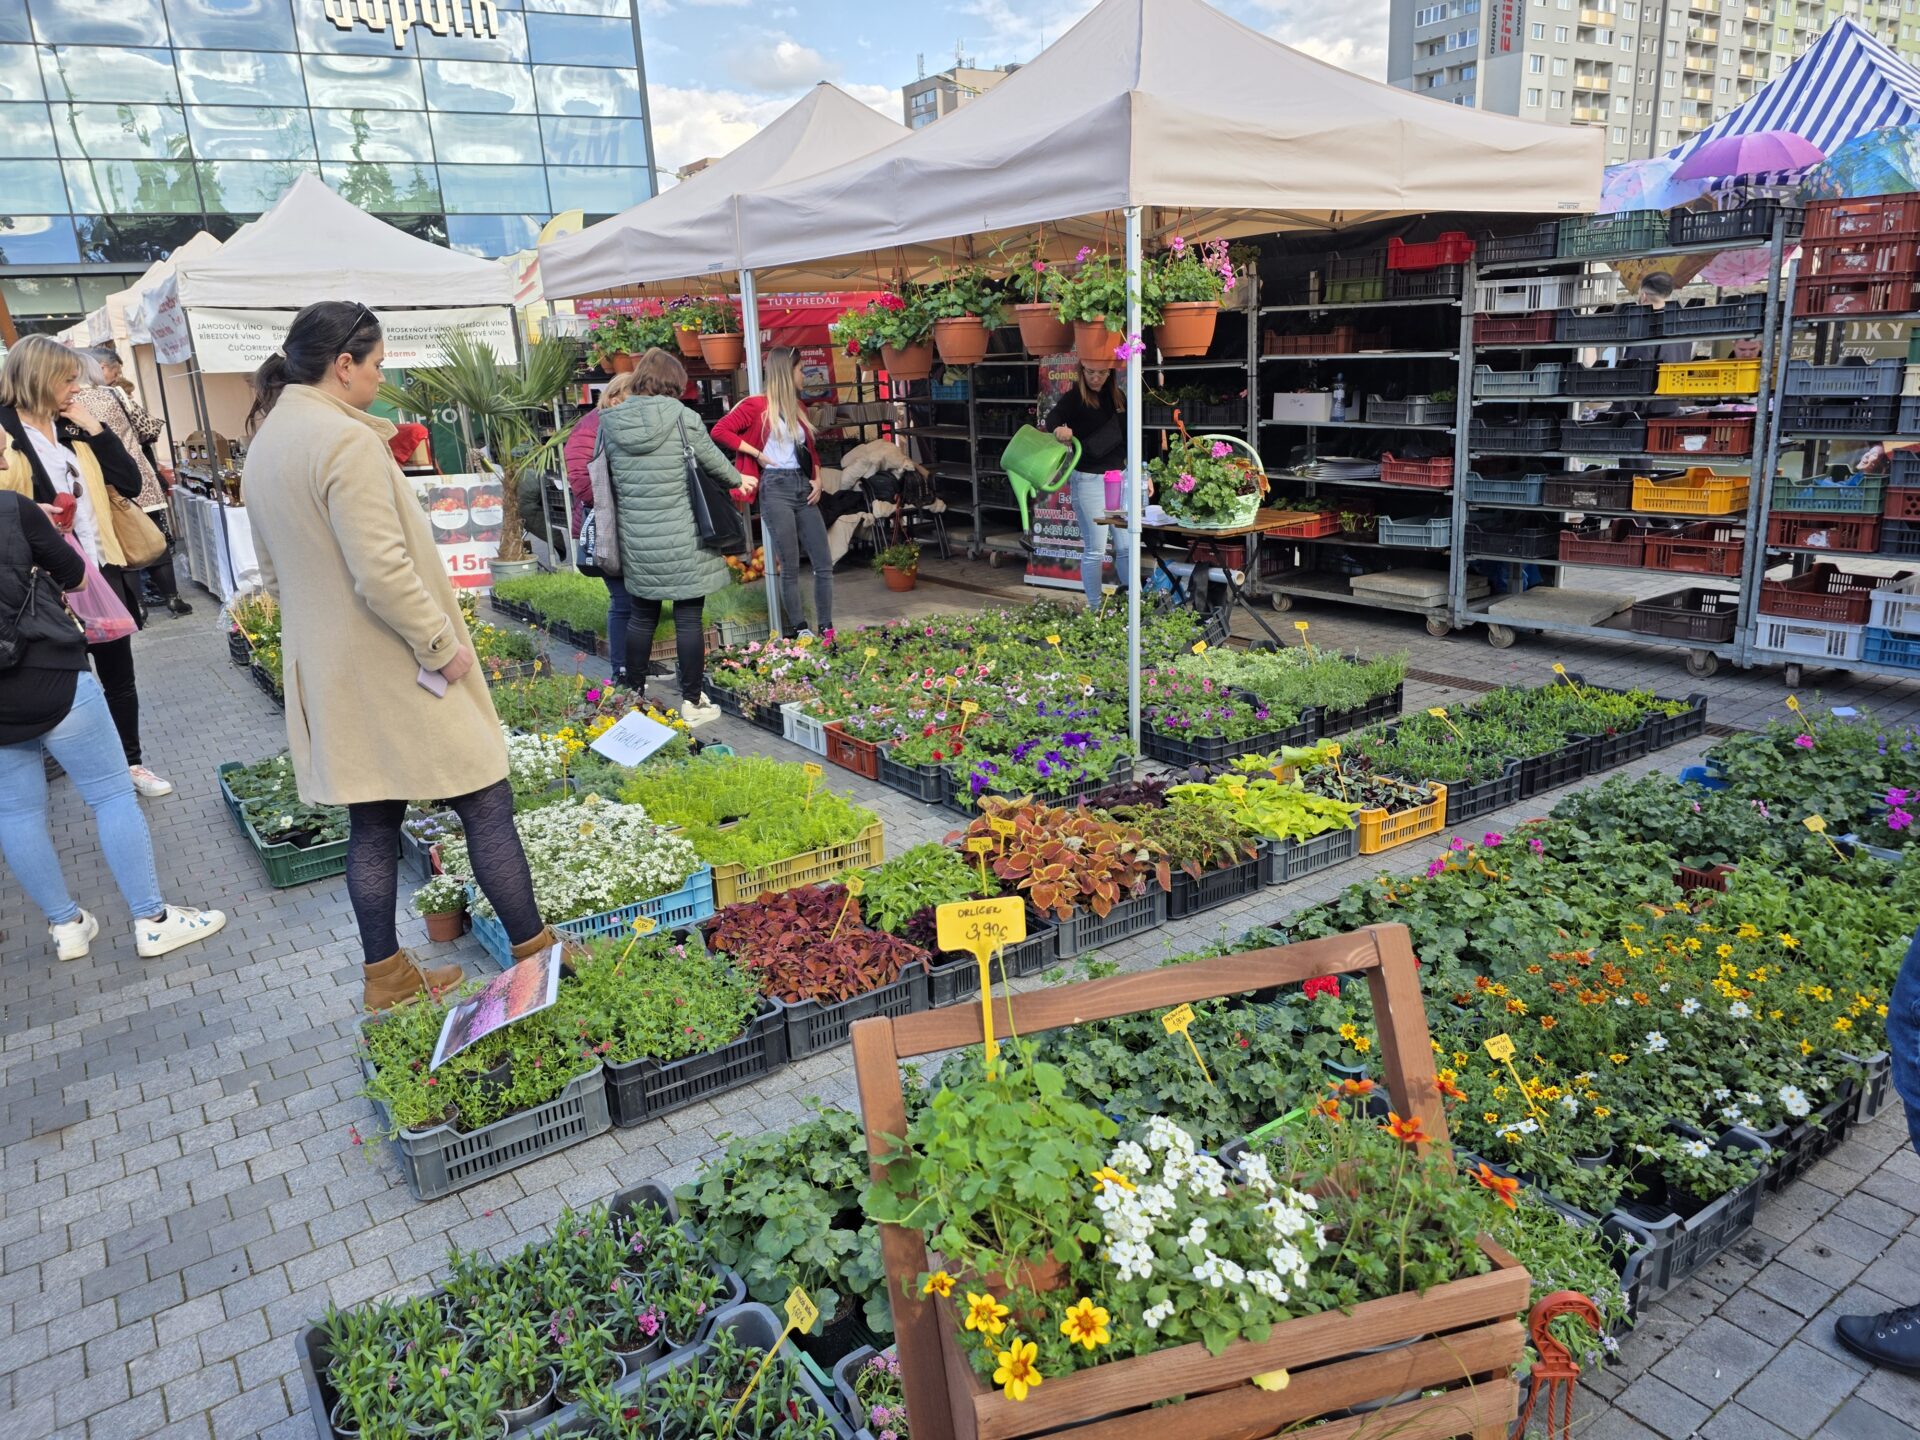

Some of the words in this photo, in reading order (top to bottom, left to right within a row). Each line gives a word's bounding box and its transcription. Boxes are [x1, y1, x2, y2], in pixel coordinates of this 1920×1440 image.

[768, 298, 782, 306] TU
[785, 298, 793, 306] V
[242, 322, 263, 331] VÍNO
[491, 320, 509, 328] VÍNO
[241, 332, 261, 340] VÍNO
[1048, 370, 1079, 380] Gomba
[1034, 507, 1077, 520] www.ha
